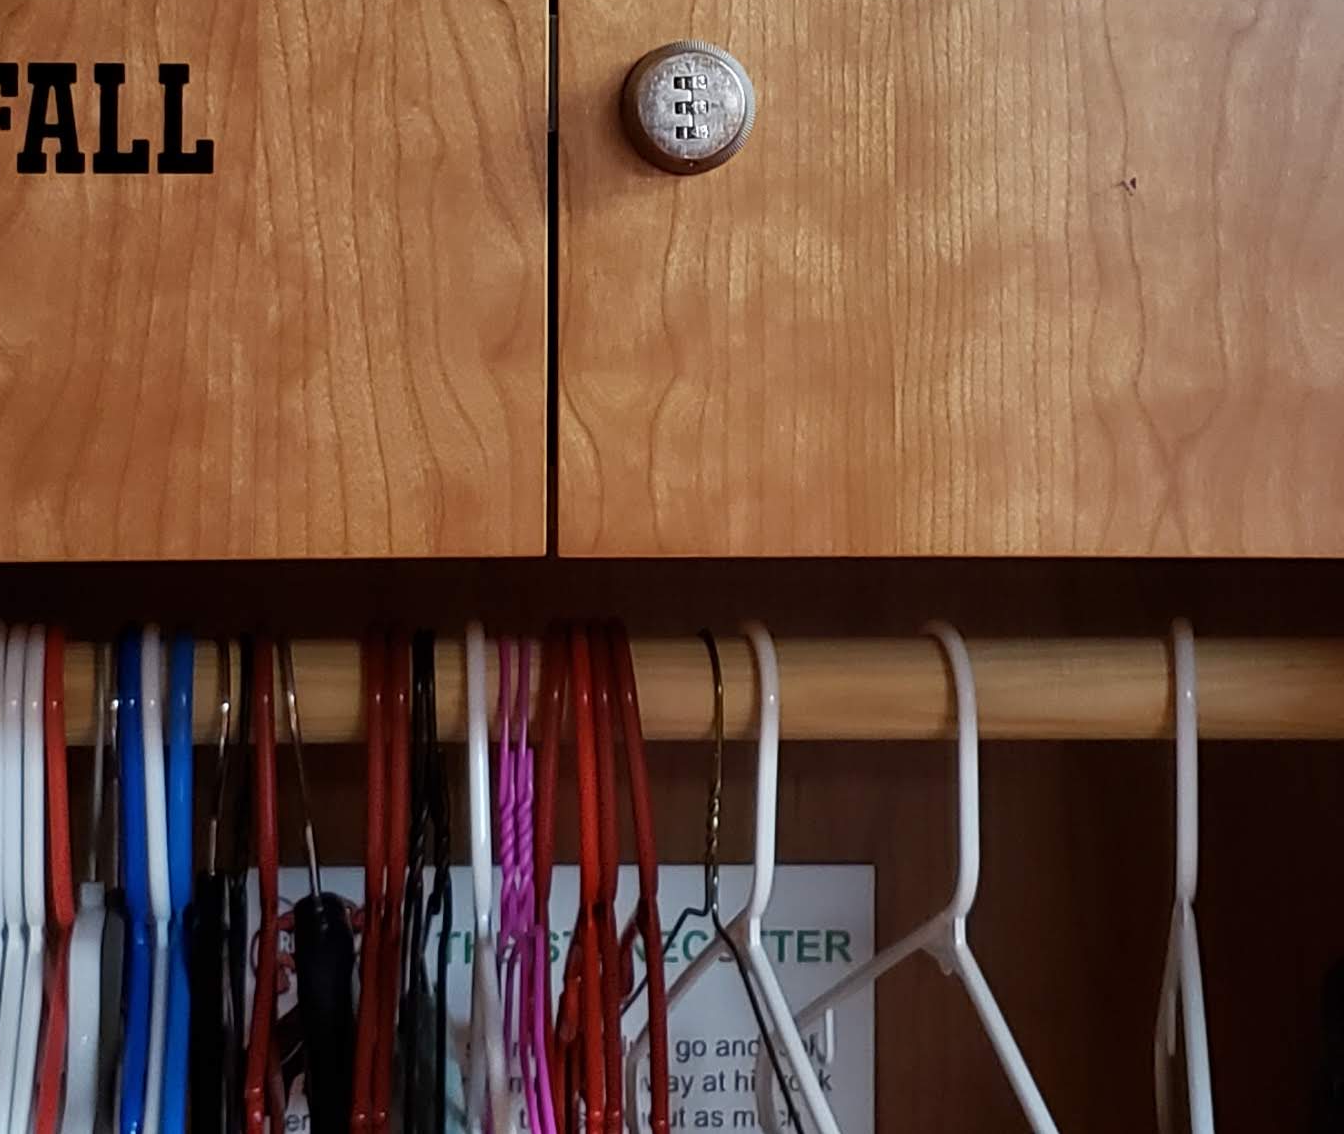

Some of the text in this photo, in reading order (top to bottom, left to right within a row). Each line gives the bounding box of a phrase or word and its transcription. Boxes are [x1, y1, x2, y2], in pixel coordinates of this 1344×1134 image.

[675, 1039, 707, 1063] go
[702, 1071, 725, 1092] at
[694, 1111, 724, 1127] as
